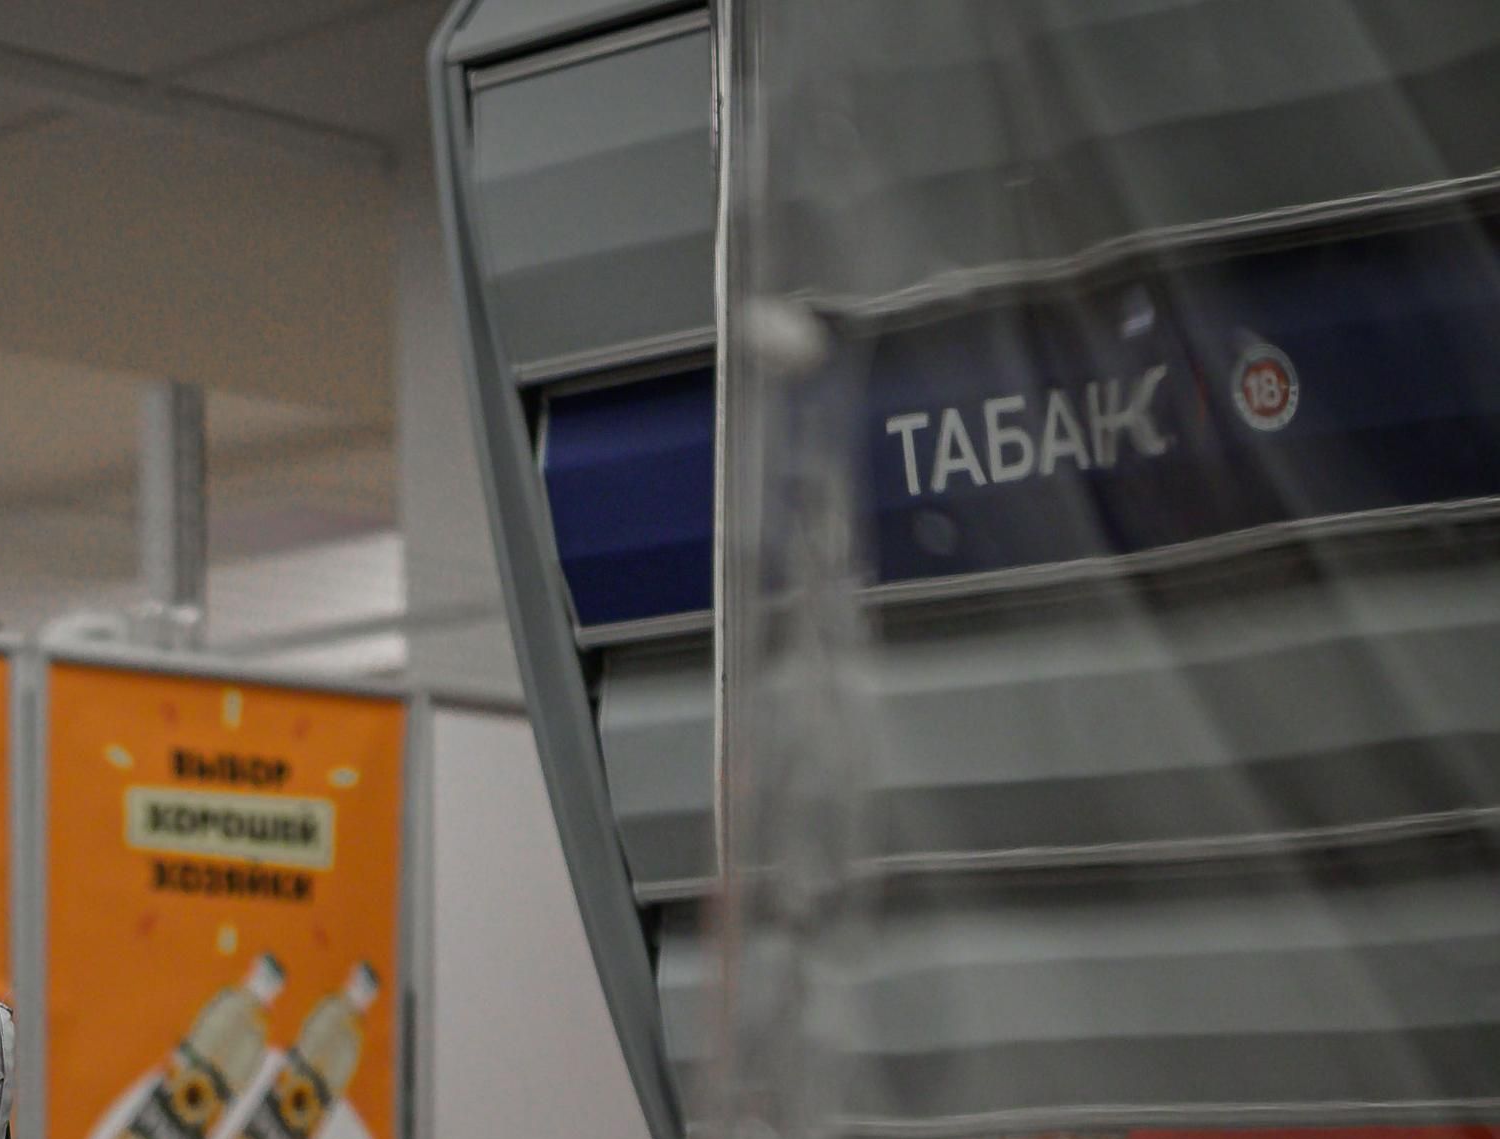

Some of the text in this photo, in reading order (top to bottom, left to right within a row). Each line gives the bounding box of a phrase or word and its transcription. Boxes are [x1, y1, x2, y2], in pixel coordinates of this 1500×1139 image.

[886, 364, 1176, 496] ТАБАК
[172, 747, 290, 787] ВЫБОР
[148, 801, 318, 846] ХОРОШЕЙ
[154, 859, 314, 900] ХОЗЯЙКИ
